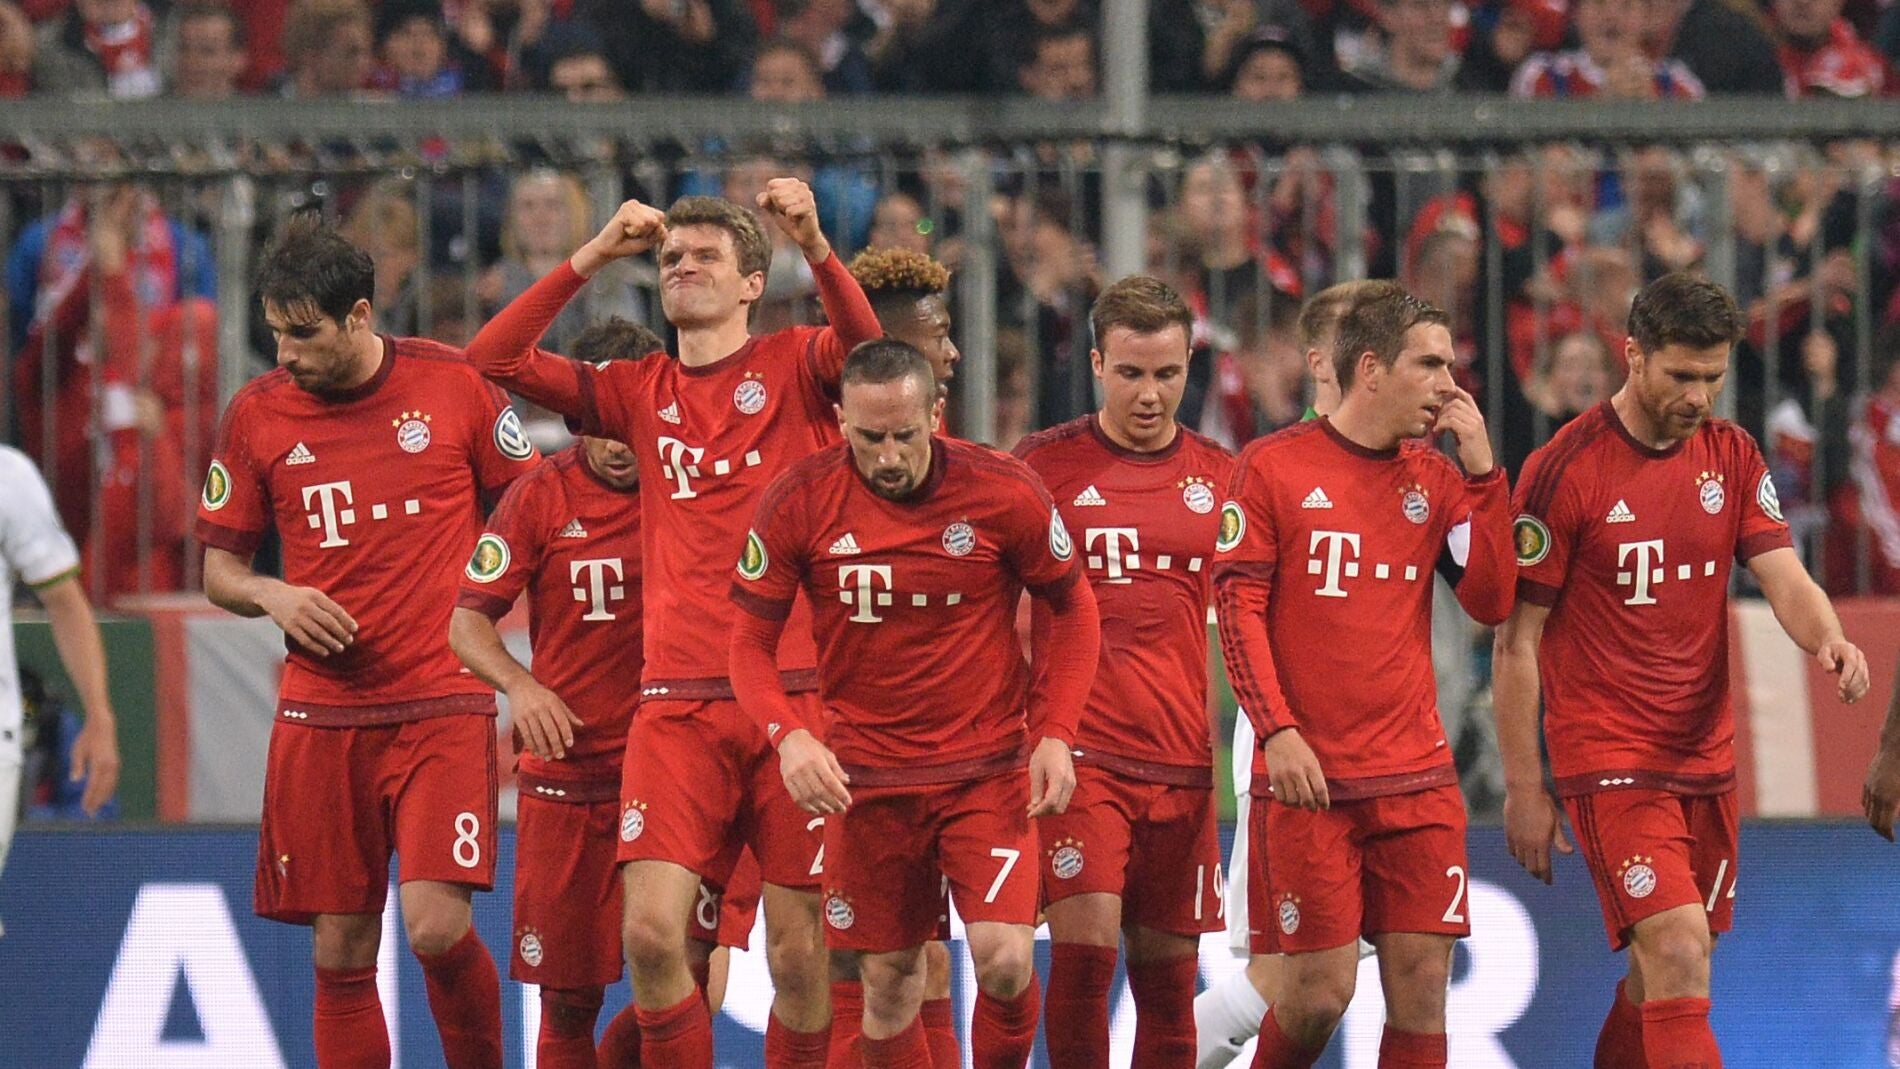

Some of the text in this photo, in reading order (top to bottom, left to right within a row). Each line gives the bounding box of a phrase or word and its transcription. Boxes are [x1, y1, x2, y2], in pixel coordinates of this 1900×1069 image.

[452, 811, 480, 868] 8
[984, 847, 1021, 903] 7
[1194, 862, 1224, 920] 19
[1441, 865, 1465, 924] 2
